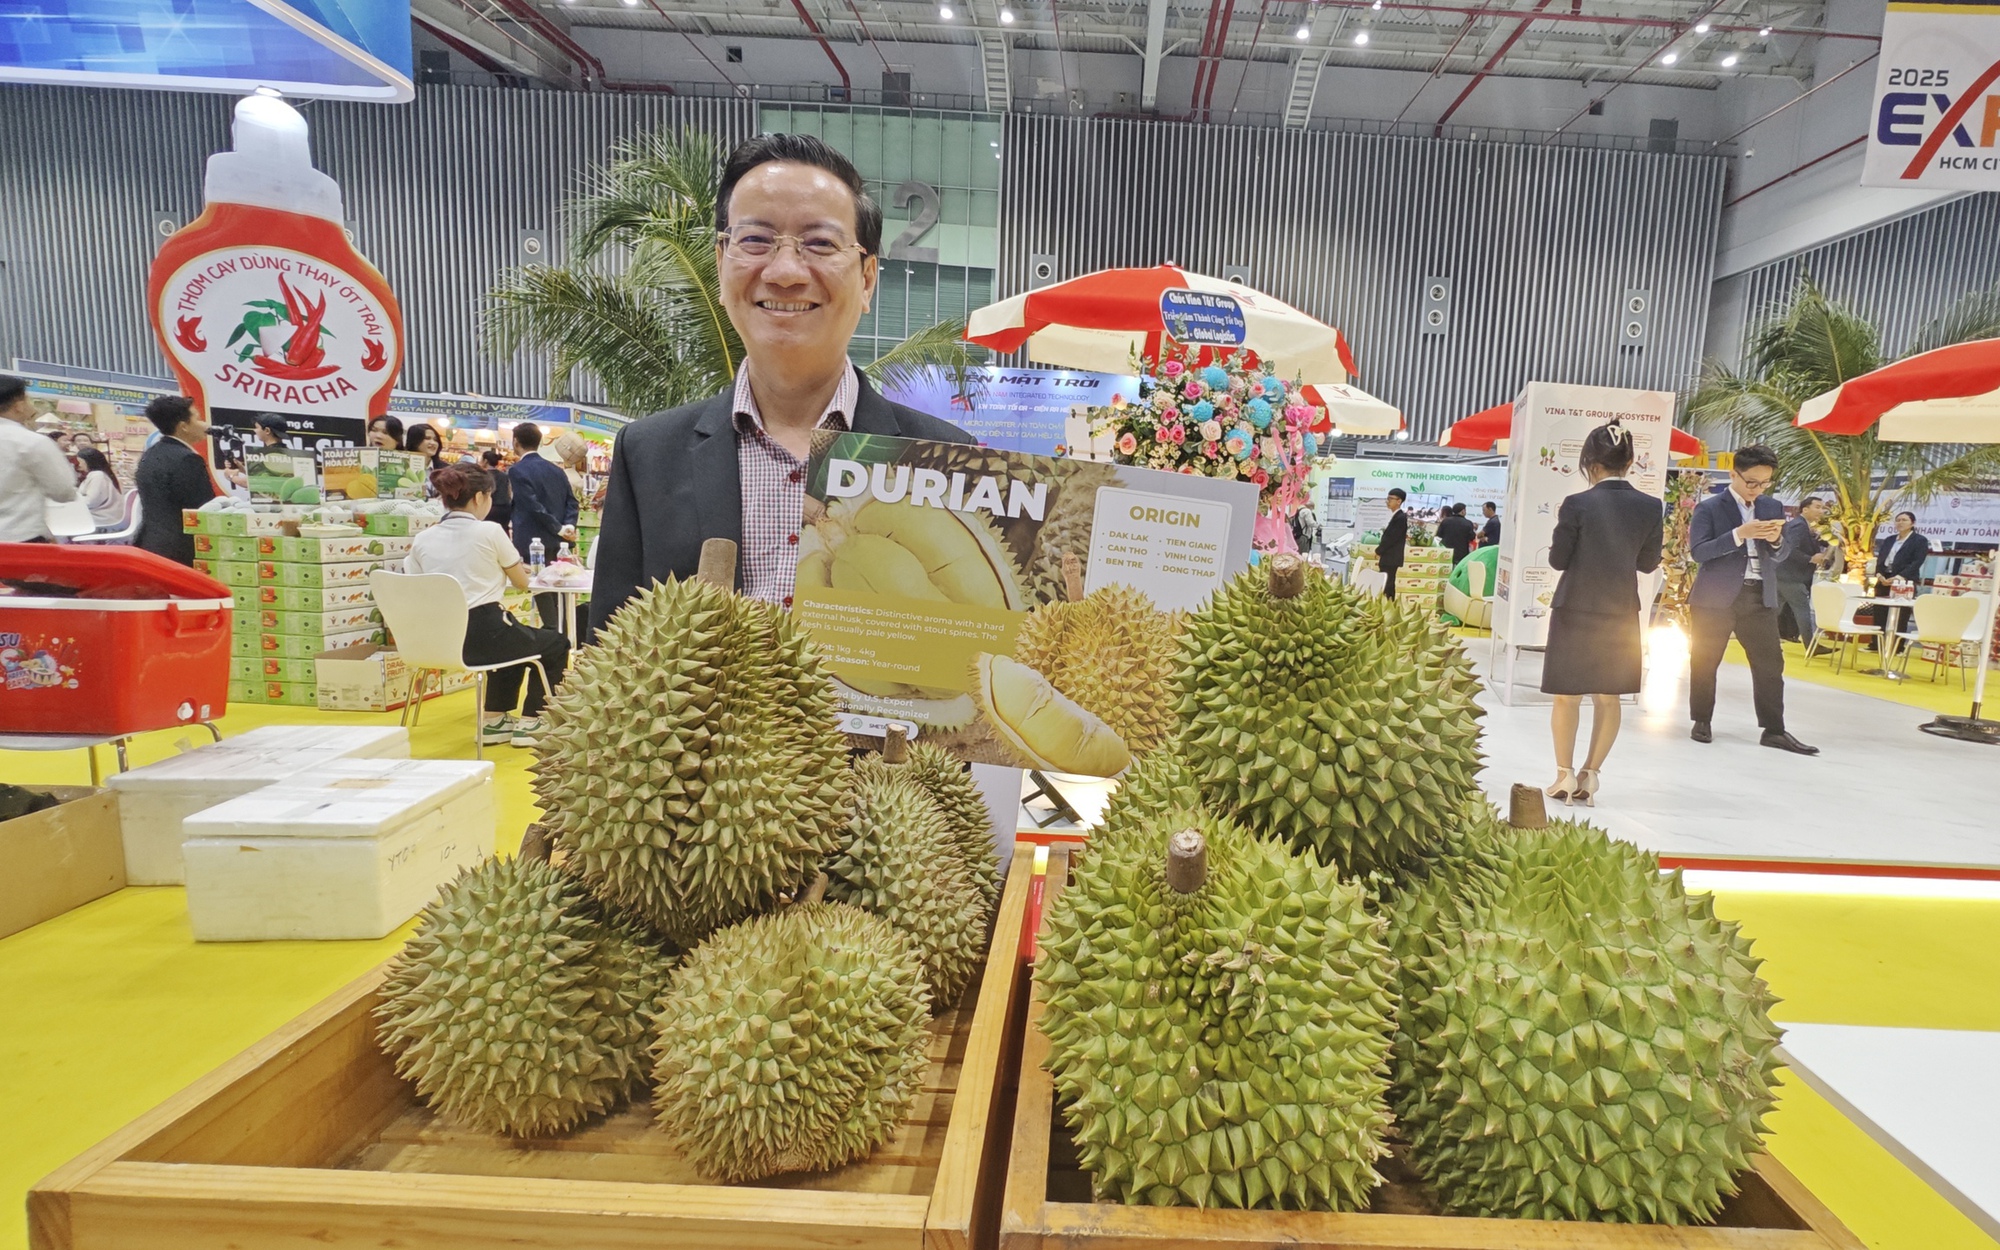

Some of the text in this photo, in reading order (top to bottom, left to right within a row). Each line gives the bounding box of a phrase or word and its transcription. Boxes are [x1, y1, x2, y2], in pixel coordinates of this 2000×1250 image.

[1888, 68, 1949, 87] 2025
[1939, 157, 2000, 170] HCM CI
[178, 253, 382, 336] THƠM CAY DÙNG THAY ỚT TRÁI
[1169, 292, 1186, 304] Chúc
[1186, 293, 1202, 306] Vina
[1202, 295, 1215, 307] T&T
[1216, 297, 1236, 312] Group
[1193, 327, 1213, 340] Global
[1213, 328, 1237, 344] Logistics
[38, 381, 68, 390] GIAN
[215, 363, 358, 404] SRIRACHA
[999, 373, 1046, 388] MẶT
[1052, 375, 1100, 389] TRỜI
[1008, 391, 1047, 400] INTEGRATED
[1048, 393, 1090, 402] TECHNOLOGY
[455, 409, 529, 420] DEVELOPMENT
[1544, 406, 1661, 423] VINA T&T GROUP ECOSYSTEM
[302, 419, 314, 430] ớt
[984, 421, 1016, 429] INVERTER
[246, 451, 293, 464] XOÀI THÁI
[324, 449, 360, 459] XOÀI CÁT
[324, 458, 341, 468] HÒA
[1371, 468, 1478, 482] CÔNG TY TNHH HEROPOWER
[826, 458, 1048, 522] DURIAN
[1129, 505, 1201, 528] ORIGIN
[1109, 531, 1149, 542] DAK LAK
[1956, 528, 1972, 536] AN
[1973, 527, 2000, 538] TOÀN
[1107, 544, 1148, 555] CAN THO
[1166, 538, 1217, 551] TIEN GIANG
[1105, 557, 1144, 569] BEN TRE
[1164, 551, 1214, 564] VINH LONG
[1162, 565, 1216, 578] DONG THAP
[803, 600, 874, 615] Characteristics:
[875, 608, 923, 622] Distinctive
[924, 616, 953, 625] aroma
[955, 619, 974, 628] with
[983, 621, 1005, 632] hard
[801, 620, 918, 641] flesh is usually pale yellow.
[802, 610, 998, 641] external husk, covered with stout spines. The
[837, 644, 851, 654] 1kg
[859, 647, 876, 658] 4kg
[835, 654, 870, 666] Season:
[872, 659, 920, 672] Year-round
[387, 667, 406, 677] FRUIT
[851, 690, 861, 702] by
[864, 694, 881, 703] U.S.
[883, 697, 914, 708] Export
[834, 701, 930, 719] ationally Recognized
